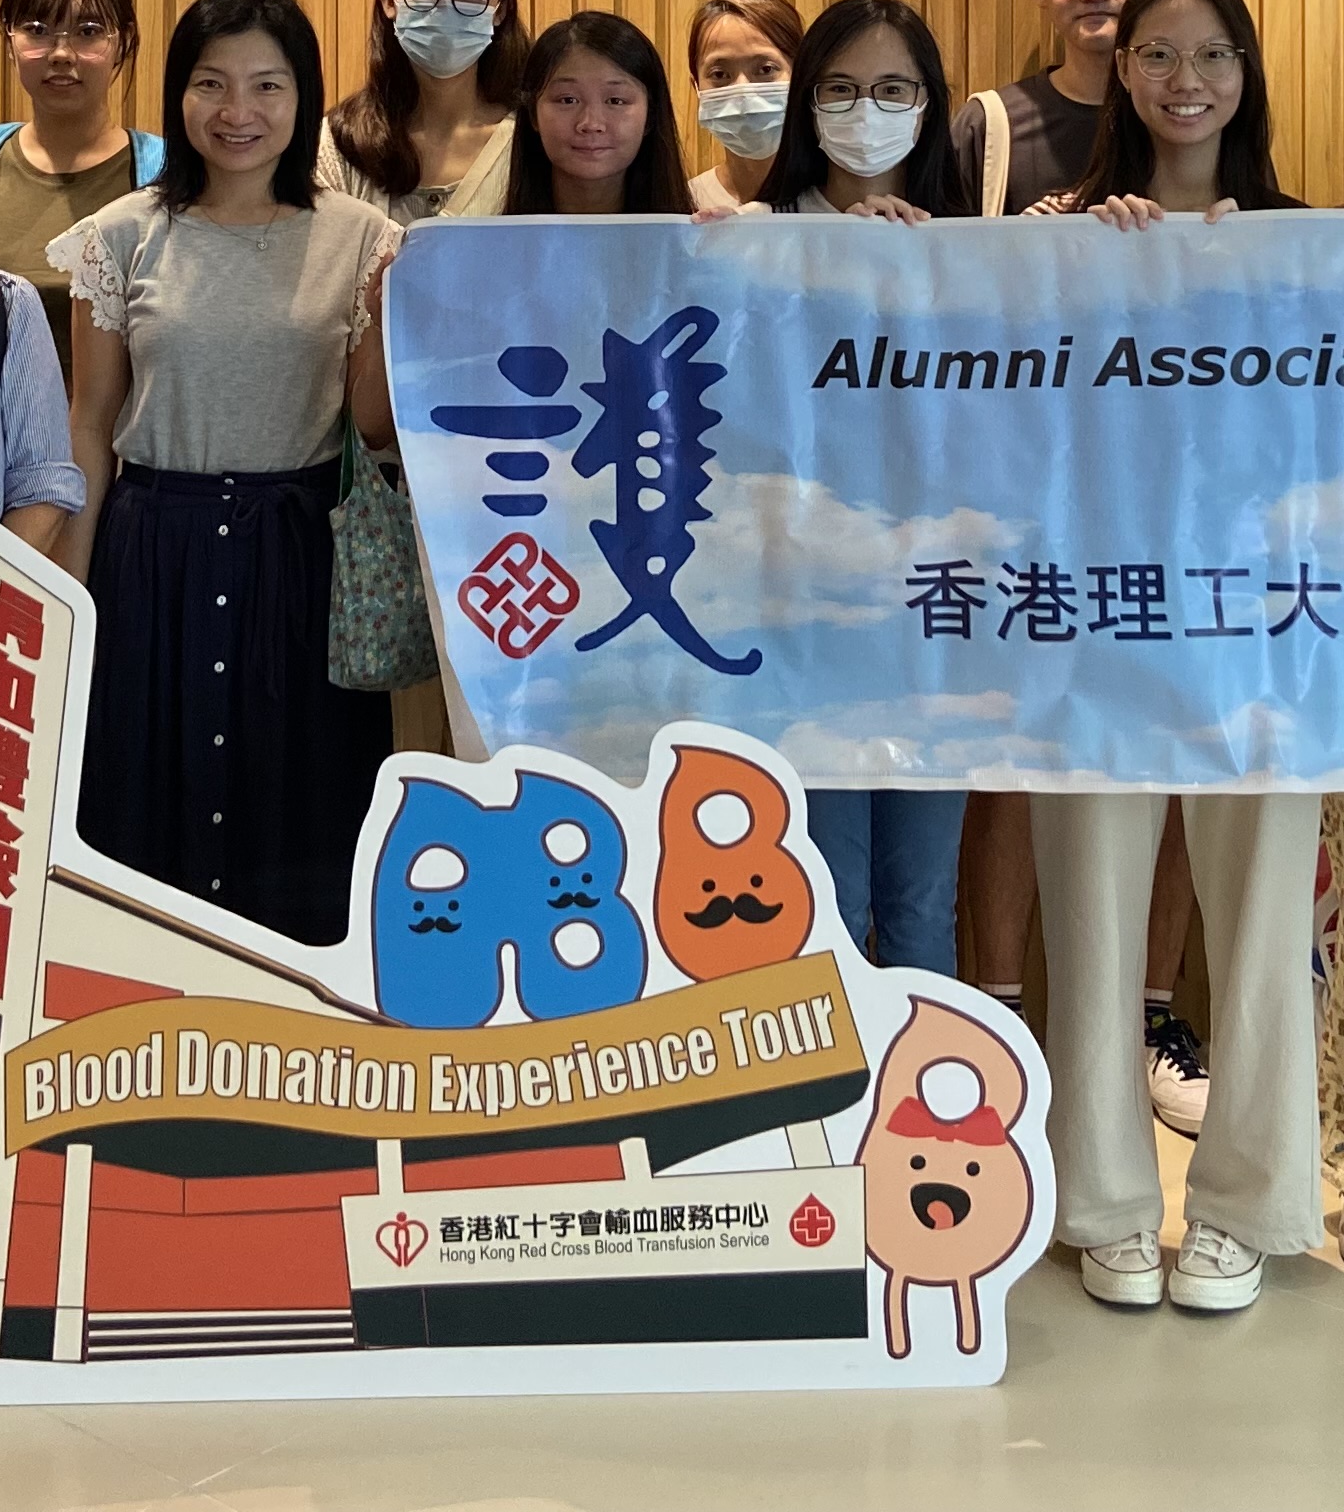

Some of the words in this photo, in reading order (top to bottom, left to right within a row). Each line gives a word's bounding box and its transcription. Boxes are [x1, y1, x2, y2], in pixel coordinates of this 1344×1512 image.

[812, 334, 1075, 390] Alumni
[23, 1031, 165, 1124] Blood
[175, 1028, 418, 1114] Donation
[429, 1024, 719, 1118] Experience
[720, 992, 837, 1069] Tour
[439, 1201, 769, 1244] 香港紅十字會輸血服務中心
[439, 1247, 476, 1265] Hong
[479, 1245, 515, 1263] Kong
[519, 1243, 547, 1259] Red
[551, 1241, 591, 1257] Cross
[594, 1239, 633, 1255] Blood
[637, 1235, 716, 1253] Transfusion
[719, 1232, 770, 1249] Service
